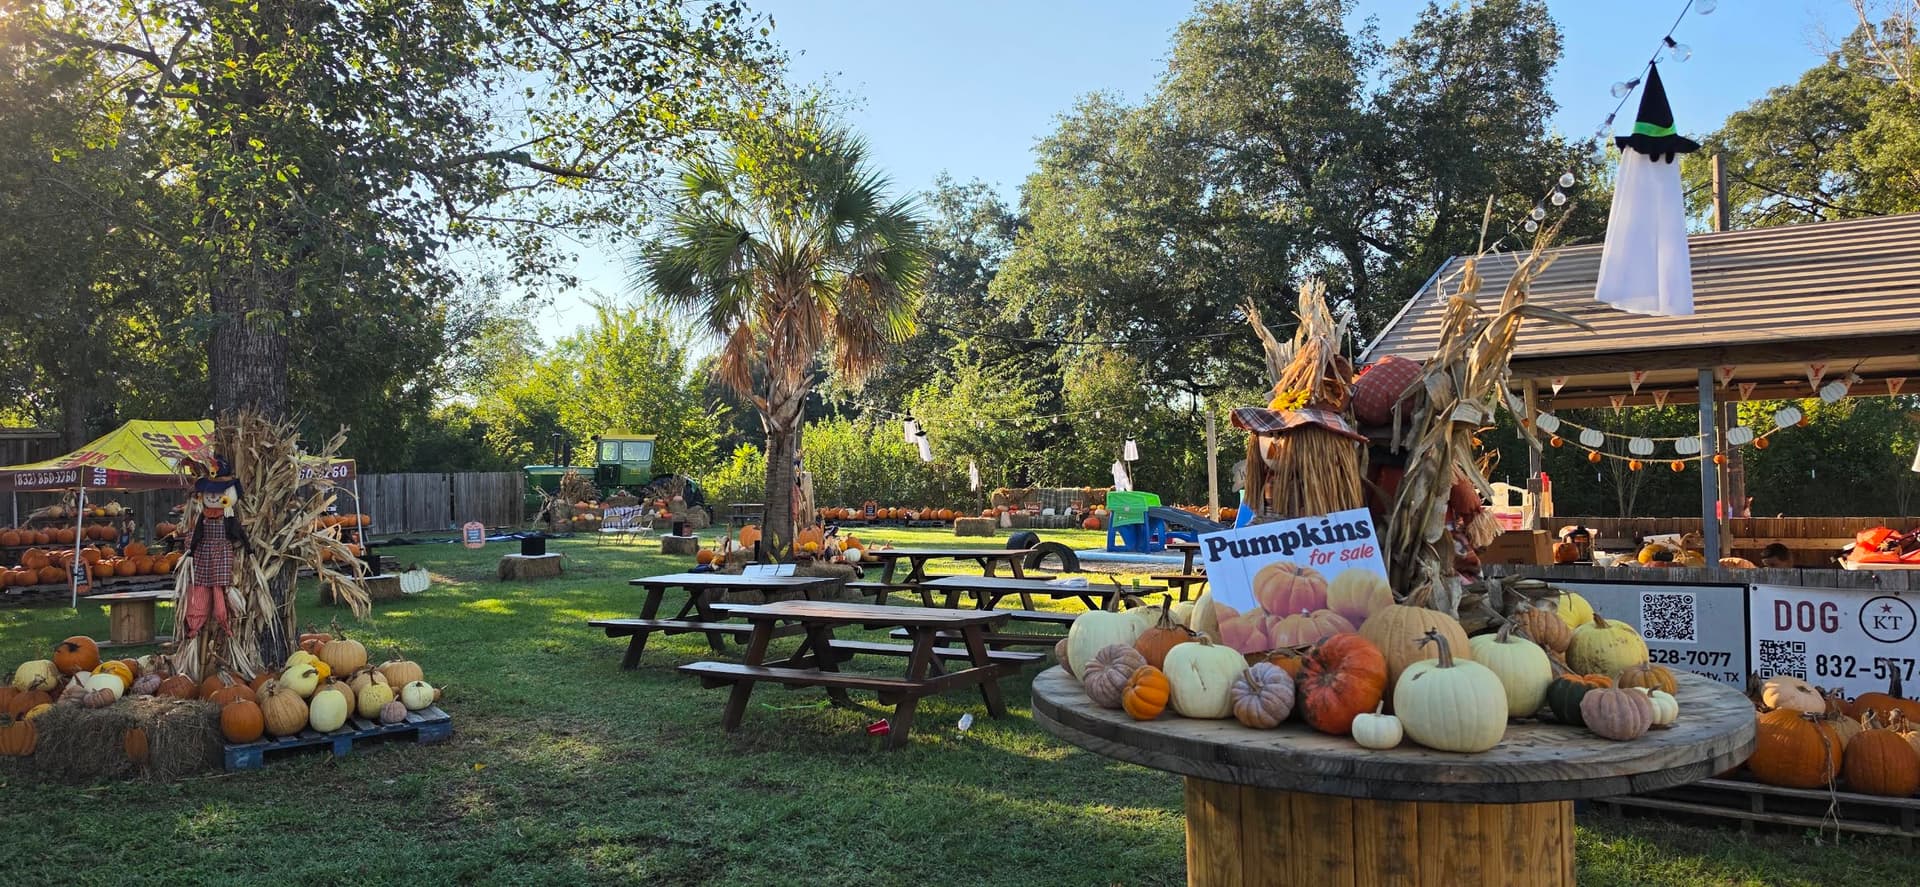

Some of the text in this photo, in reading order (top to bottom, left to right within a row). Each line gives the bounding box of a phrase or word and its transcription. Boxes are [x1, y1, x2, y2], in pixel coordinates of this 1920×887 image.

[14, 472, 37, 487] (832)
[1204, 518, 1371, 562] Pumpkins
[1309, 543, 1375, 566] for sale
[1774, 599, 1839, 633] DOG
[1873, 615, 1903, 630] KT
[1648, 648, 1731, 667] 528-7077
[1816, 654, 1920, 682] 832-557
[1723, 671, 1739, 682] TX
